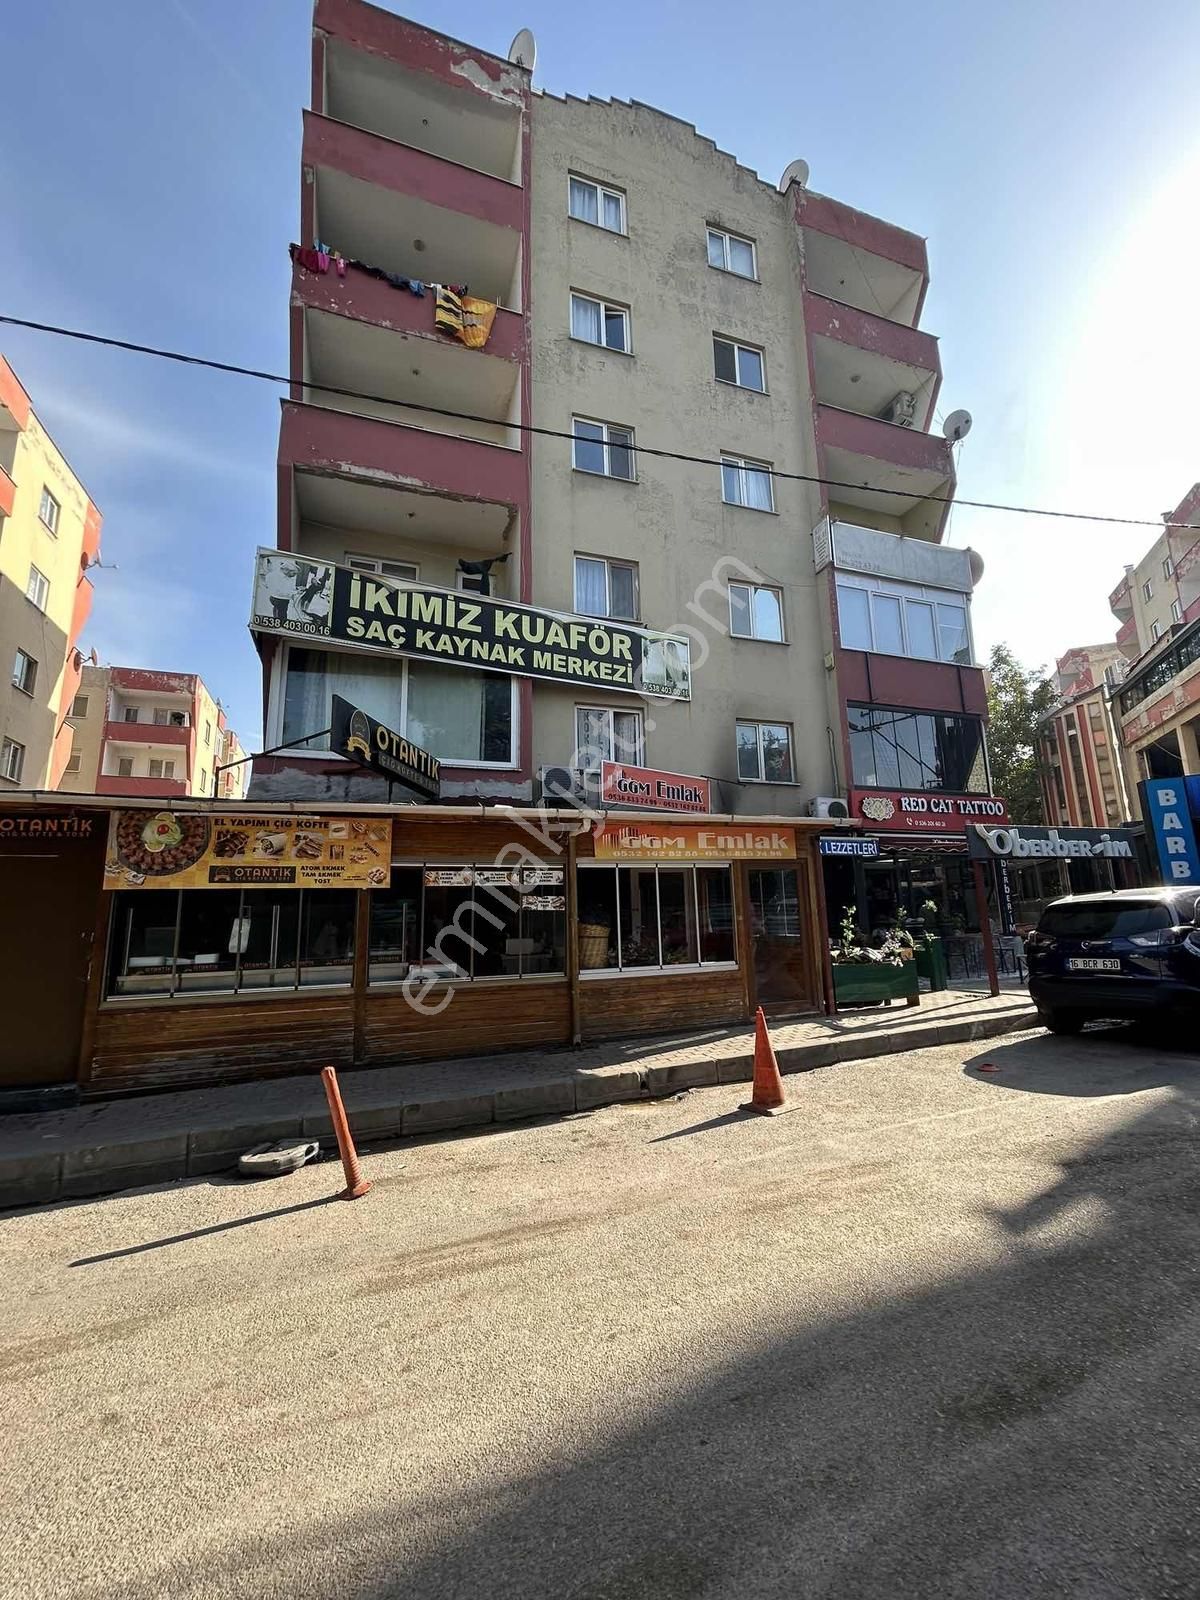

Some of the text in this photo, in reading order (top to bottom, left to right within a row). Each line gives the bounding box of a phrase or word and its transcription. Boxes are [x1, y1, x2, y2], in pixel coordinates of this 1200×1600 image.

[254, 616, 331, 636] 0 538 403 00 16
[494, 609, 633, 661] KUAFÖR
[346, 616, 633, 684] SAÇ KAYNAK MERKEZİ
[376, 725, 440, 781] OTANTİK
[617, 777, 704, 804] GGM Emlak
[900, 797, 1004, 816] RED CAT TATTOO
[0, 817, 93, 832] OTANTİK
[214, 818, 227, 827] EL
[230, 818, 270, 828] YAPIMI
[622, 832, 790, 849] GGM Emlak
[825, 840, 877, 855] LEZZETLERİ
[234, 865, 291, 877] OTANTİK
[1070, 959, 1079, 968] 16
[1102, 959, 1119, 969] 630
